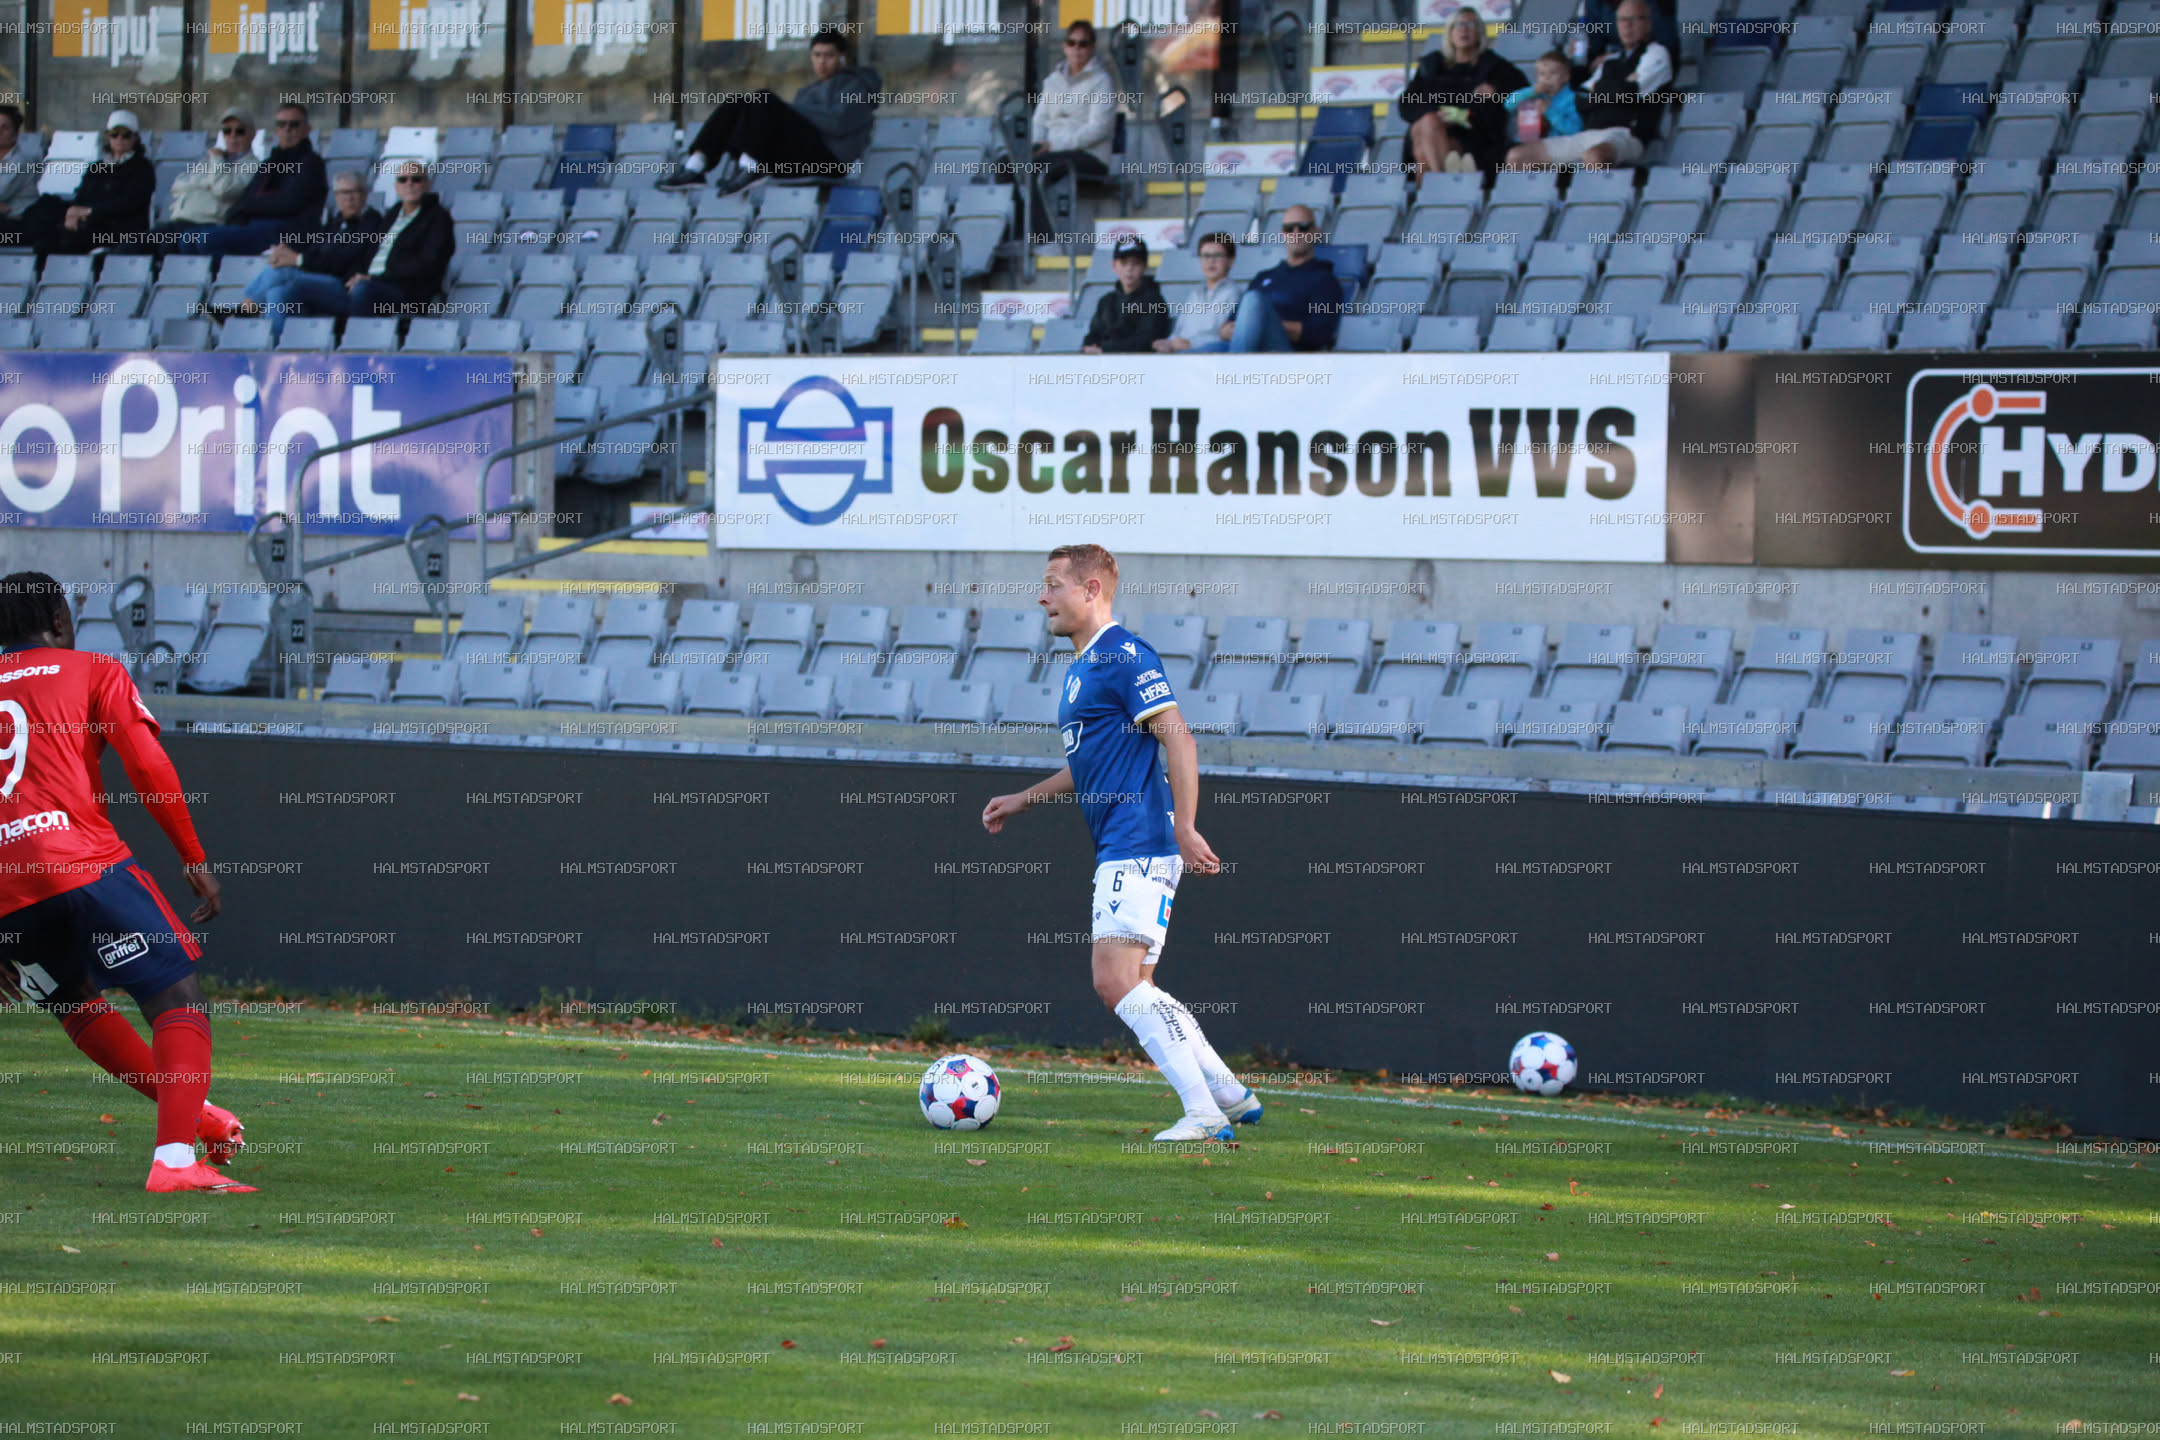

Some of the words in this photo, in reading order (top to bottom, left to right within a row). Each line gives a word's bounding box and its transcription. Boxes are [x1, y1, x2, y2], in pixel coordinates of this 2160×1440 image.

[81, 6, 159, 67] input
[238, 2, 319, 64] input
[1469, 407, 1636, 500] VVS
[1978, 426, 2160, 497] HYD
[1139, 681, 1170, 701] HFAB
[1112, 870, 1125, 892] 6
[104, 938, 141, 965] griffel
